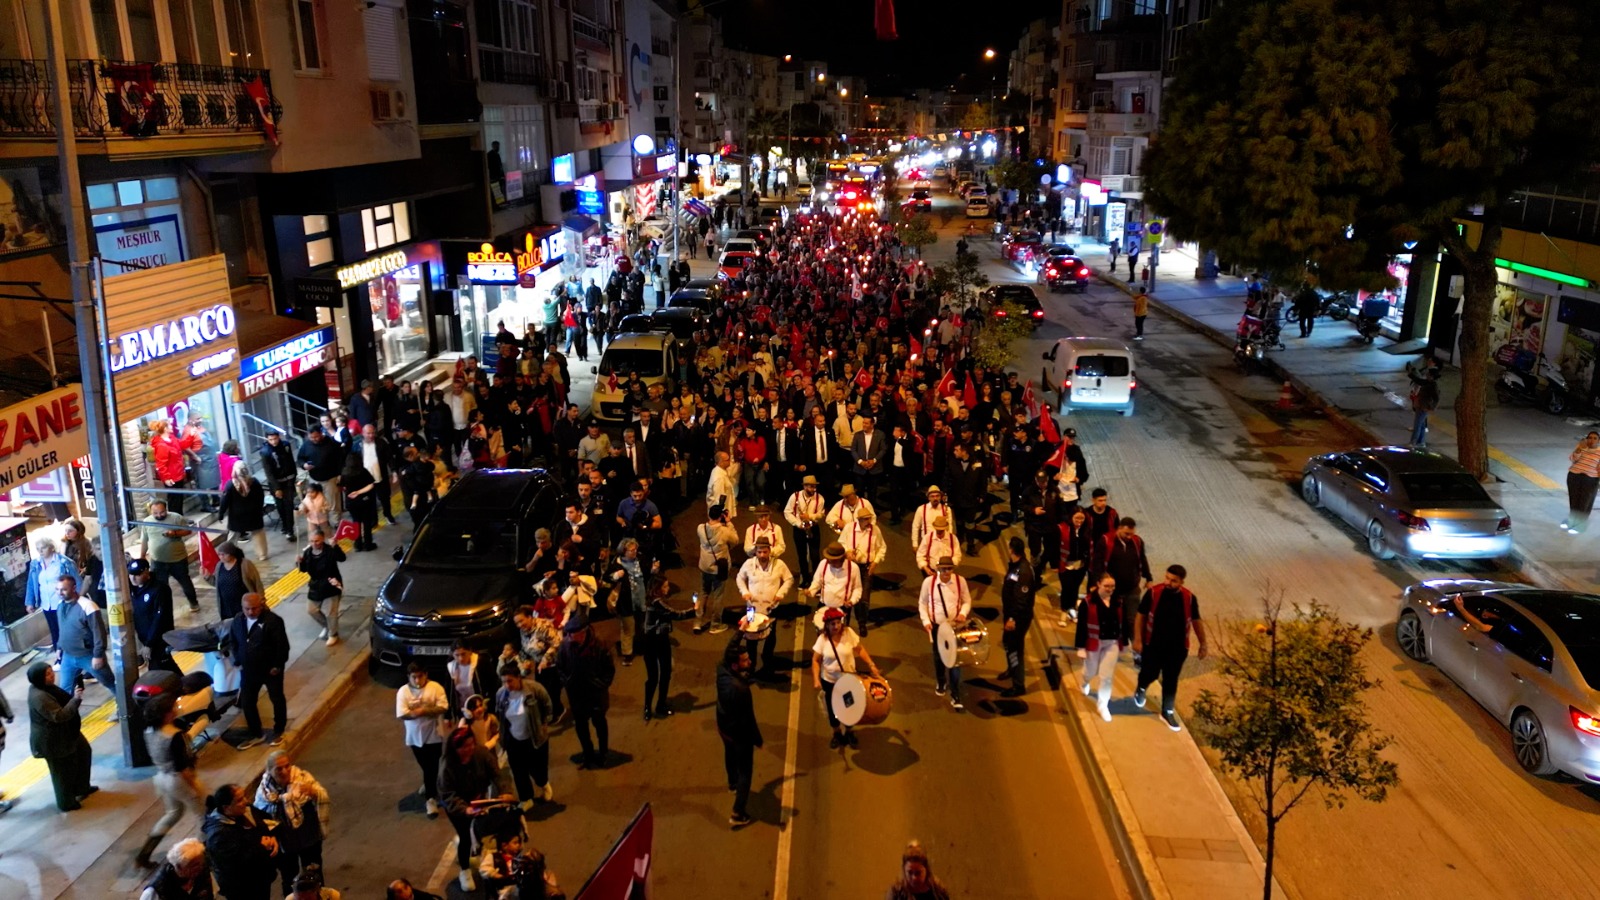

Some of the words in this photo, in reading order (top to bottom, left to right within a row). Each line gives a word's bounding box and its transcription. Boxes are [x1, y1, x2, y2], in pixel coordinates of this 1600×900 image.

[116, 230, 161, 249] MEŞHUR
[467, 252, 513, 262] BOLLCA
[243, 362, 293, 397] HASAN
[298, 346, 334, 373] AMCA
[17, 450, 58, 479] GÜLER
